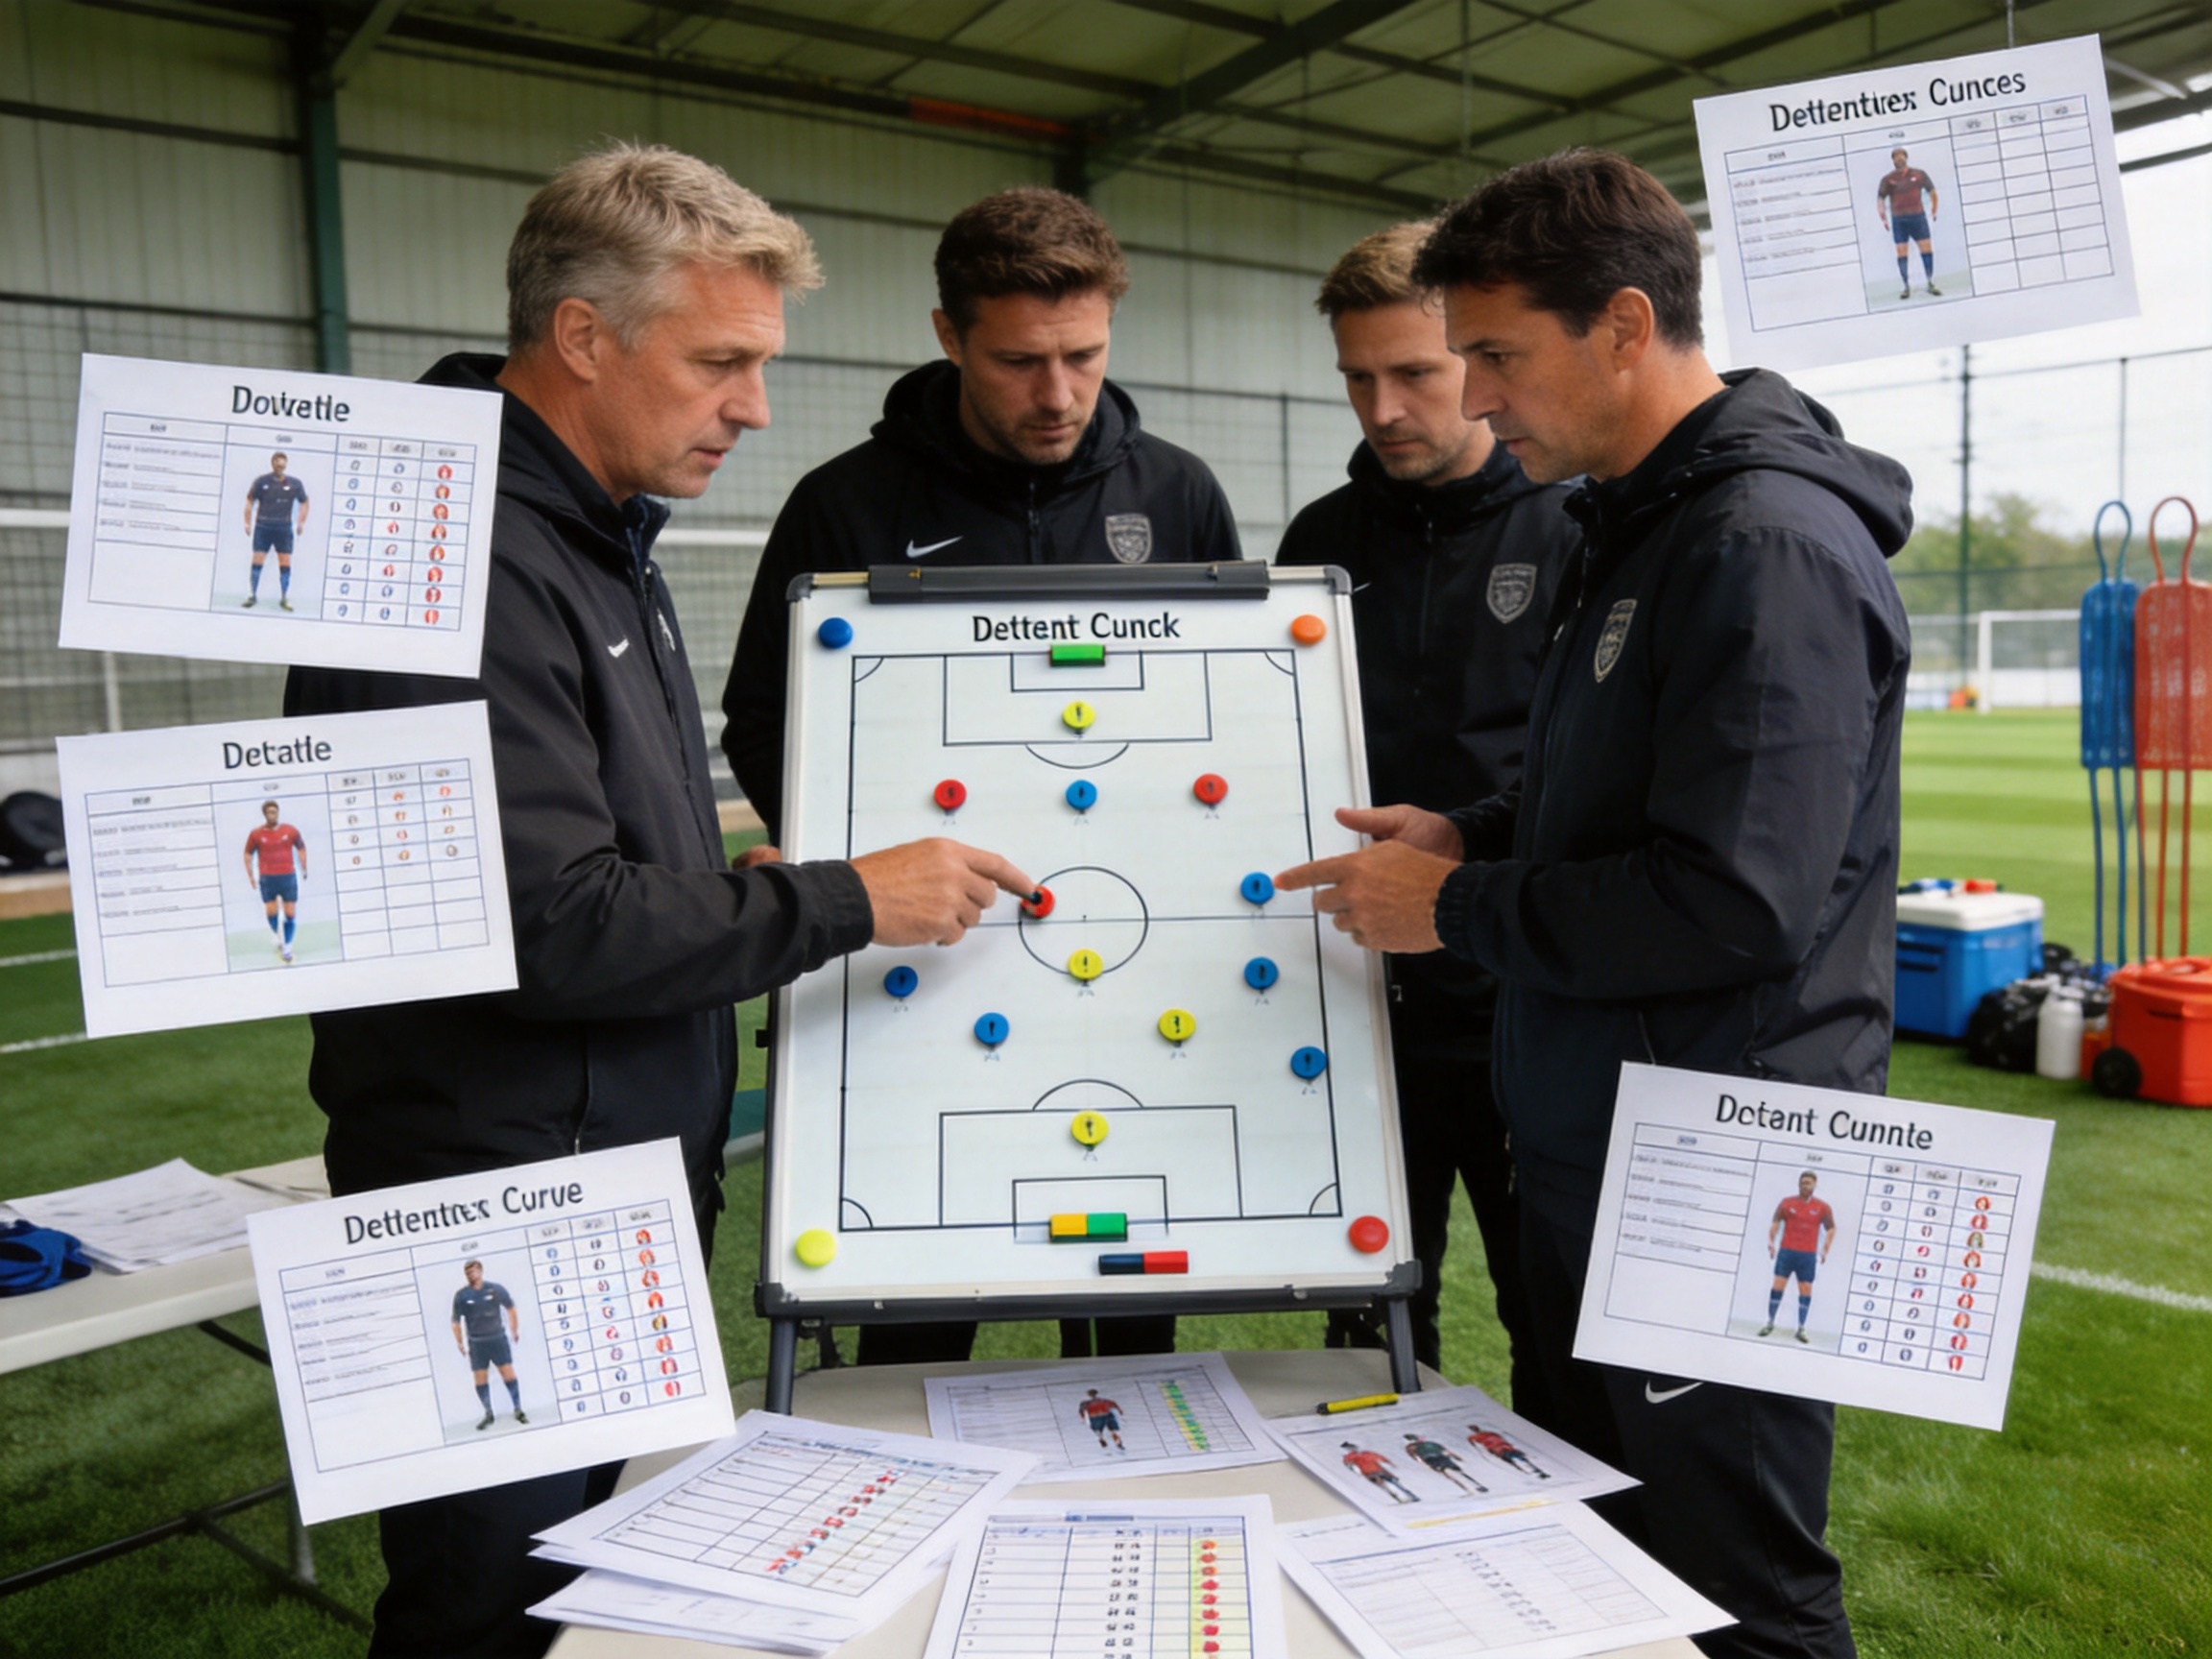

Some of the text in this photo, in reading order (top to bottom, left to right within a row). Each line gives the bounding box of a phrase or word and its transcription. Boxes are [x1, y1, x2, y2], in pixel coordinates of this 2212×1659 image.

[1929, 72, 2027, 107] Cunces
[972, 612, 1181, 642] Dettent Cunck
[502, 1183, 583, 1214] Curve
